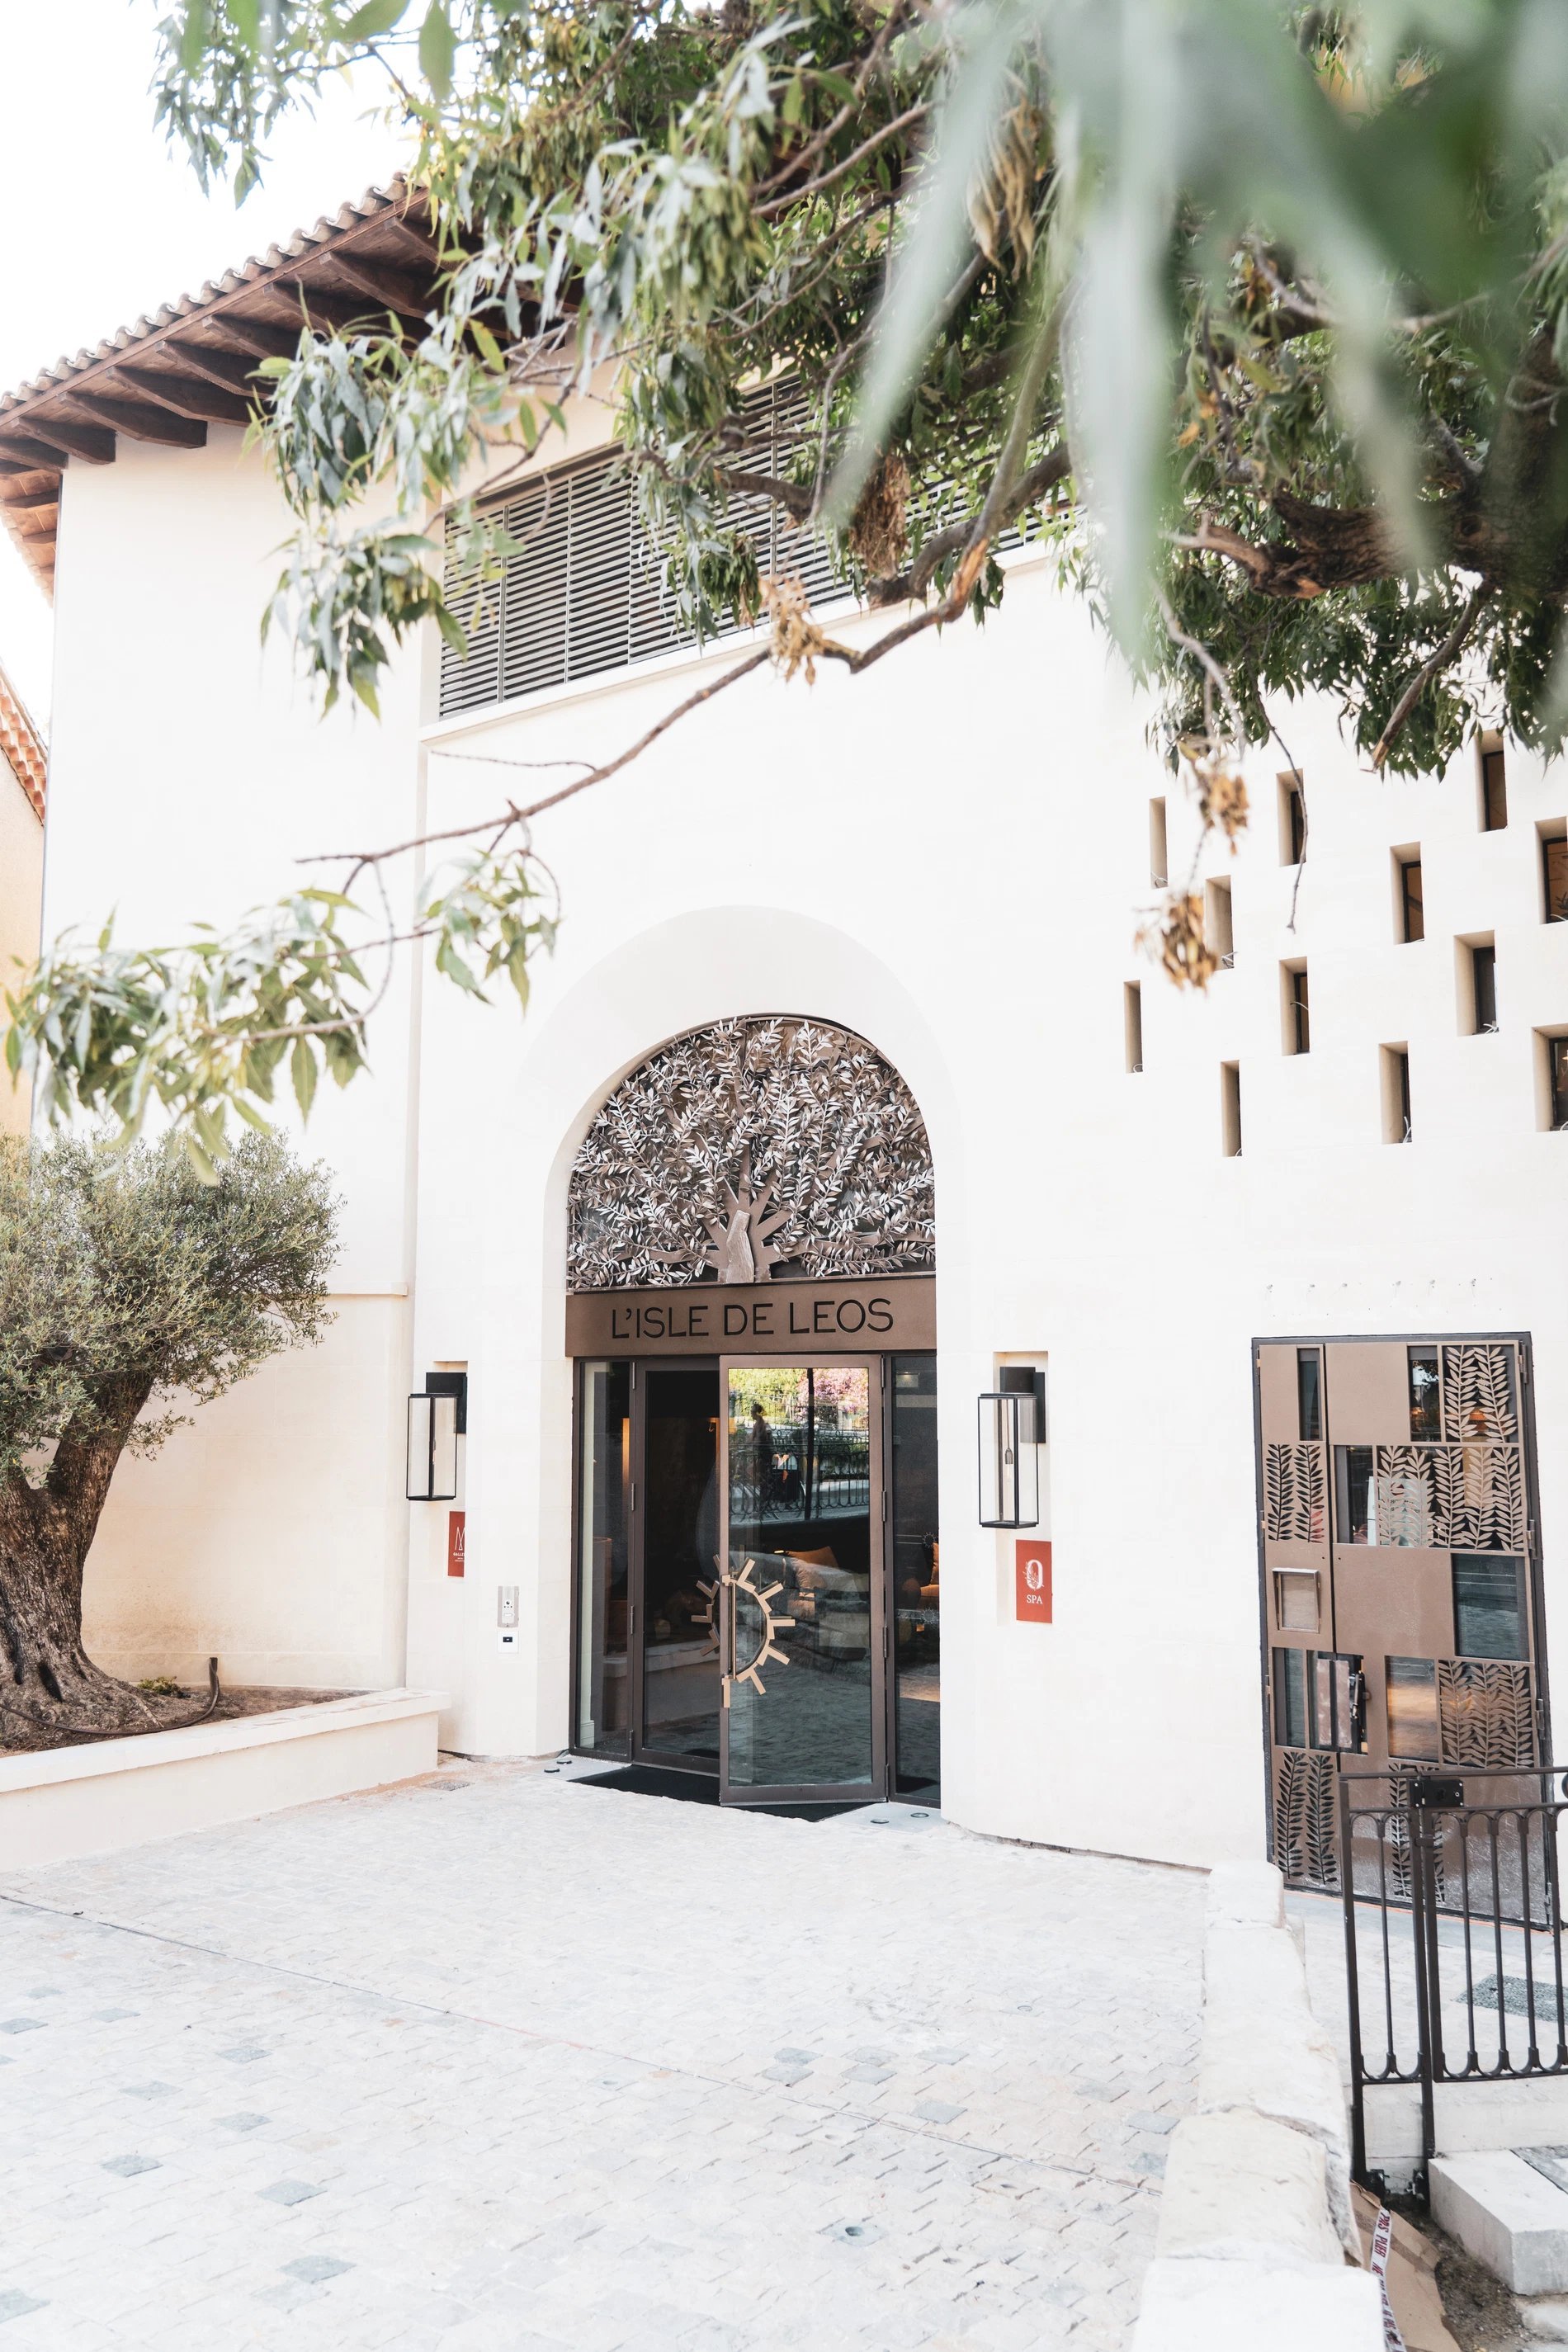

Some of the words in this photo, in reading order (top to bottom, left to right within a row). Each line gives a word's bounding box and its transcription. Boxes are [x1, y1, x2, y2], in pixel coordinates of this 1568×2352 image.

[612, 1306, 709, 1339] L'ISLE
[725, 1303, 774, 1336] DE
[790, 1297, 894, 1334] LEOS
[1026, 1594, 1043, 1604] SPA
[1378, 2212, 1390, 2233] PAS
[1374, 2234, 1388, 2258] PLIER
